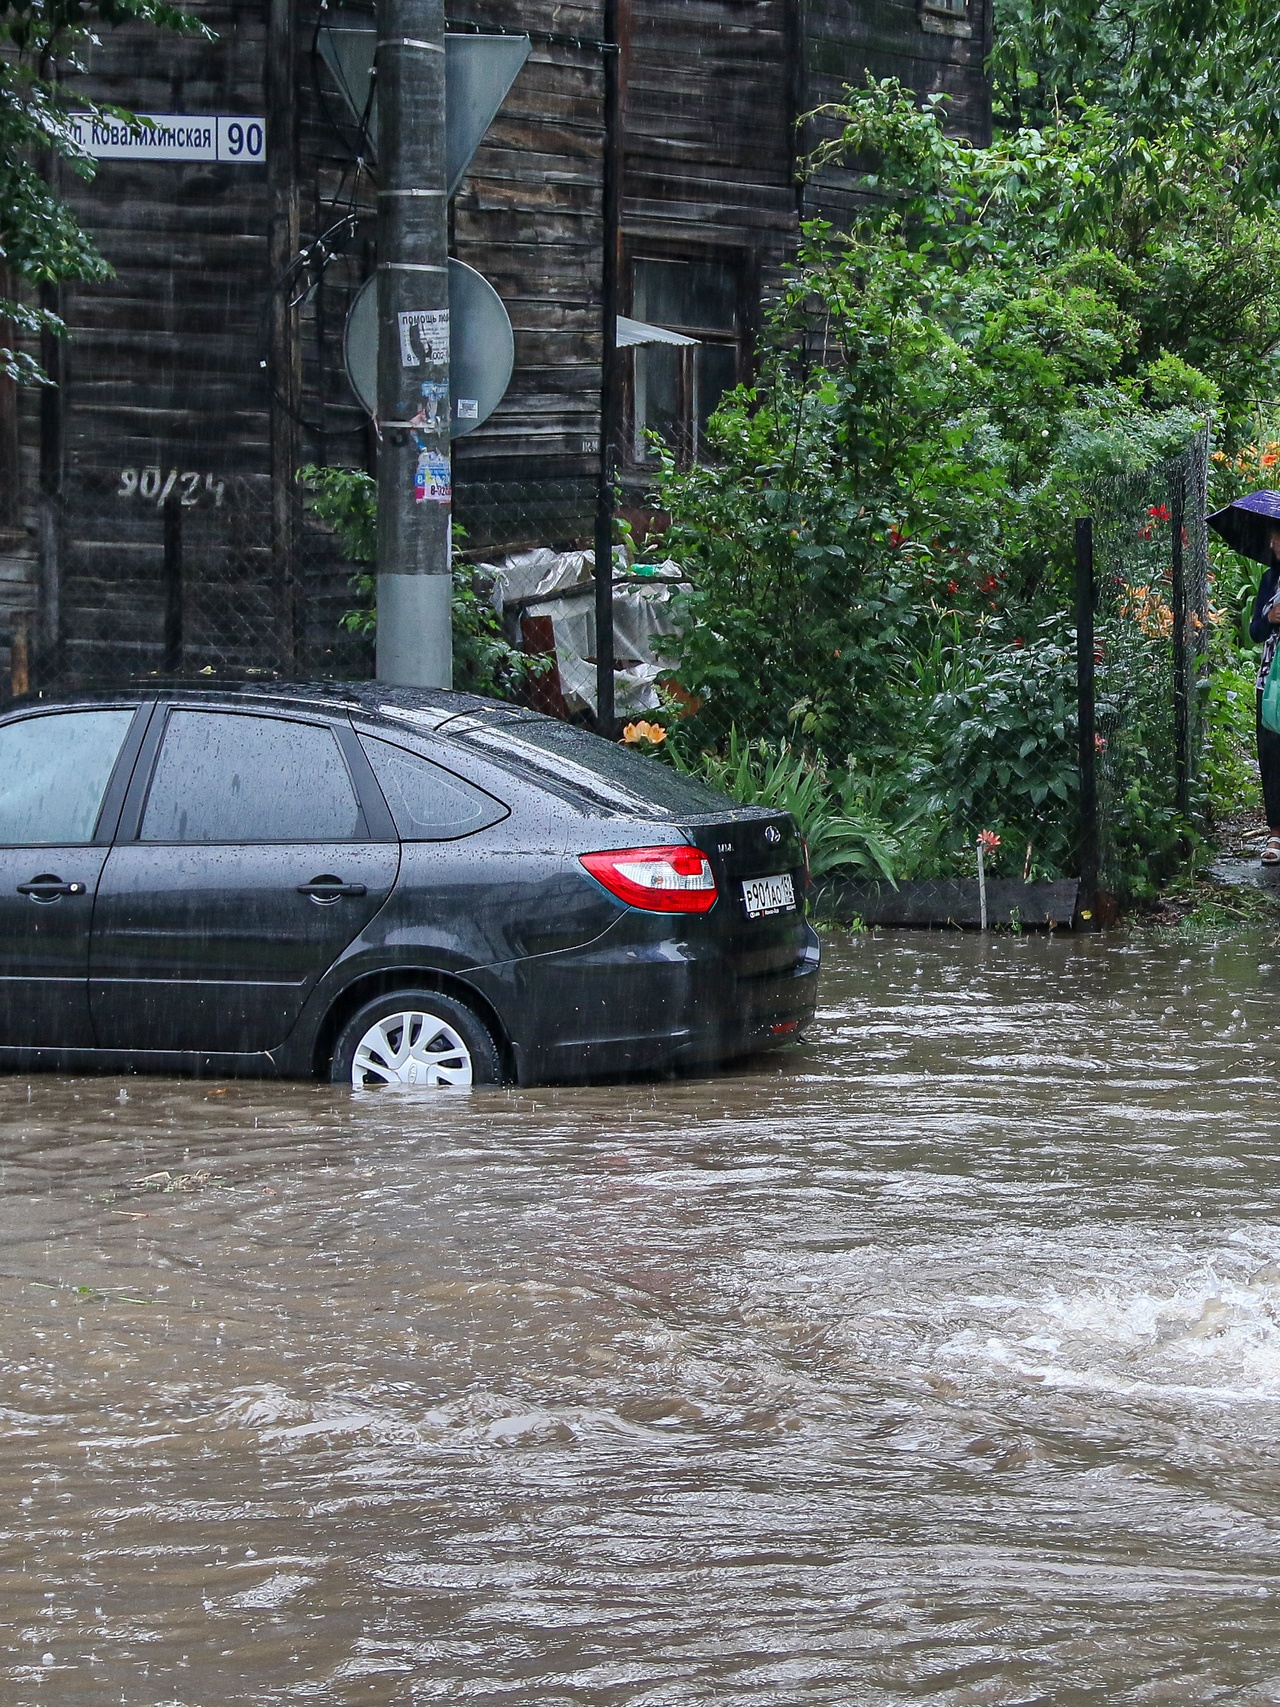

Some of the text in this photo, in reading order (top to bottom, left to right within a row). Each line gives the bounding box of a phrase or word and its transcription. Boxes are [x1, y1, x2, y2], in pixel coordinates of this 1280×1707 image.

[92, 125, 211, 148] Ковалихинская
[228, 122, 263, 156] 90
[118, 465, 225, 507] 90/24
